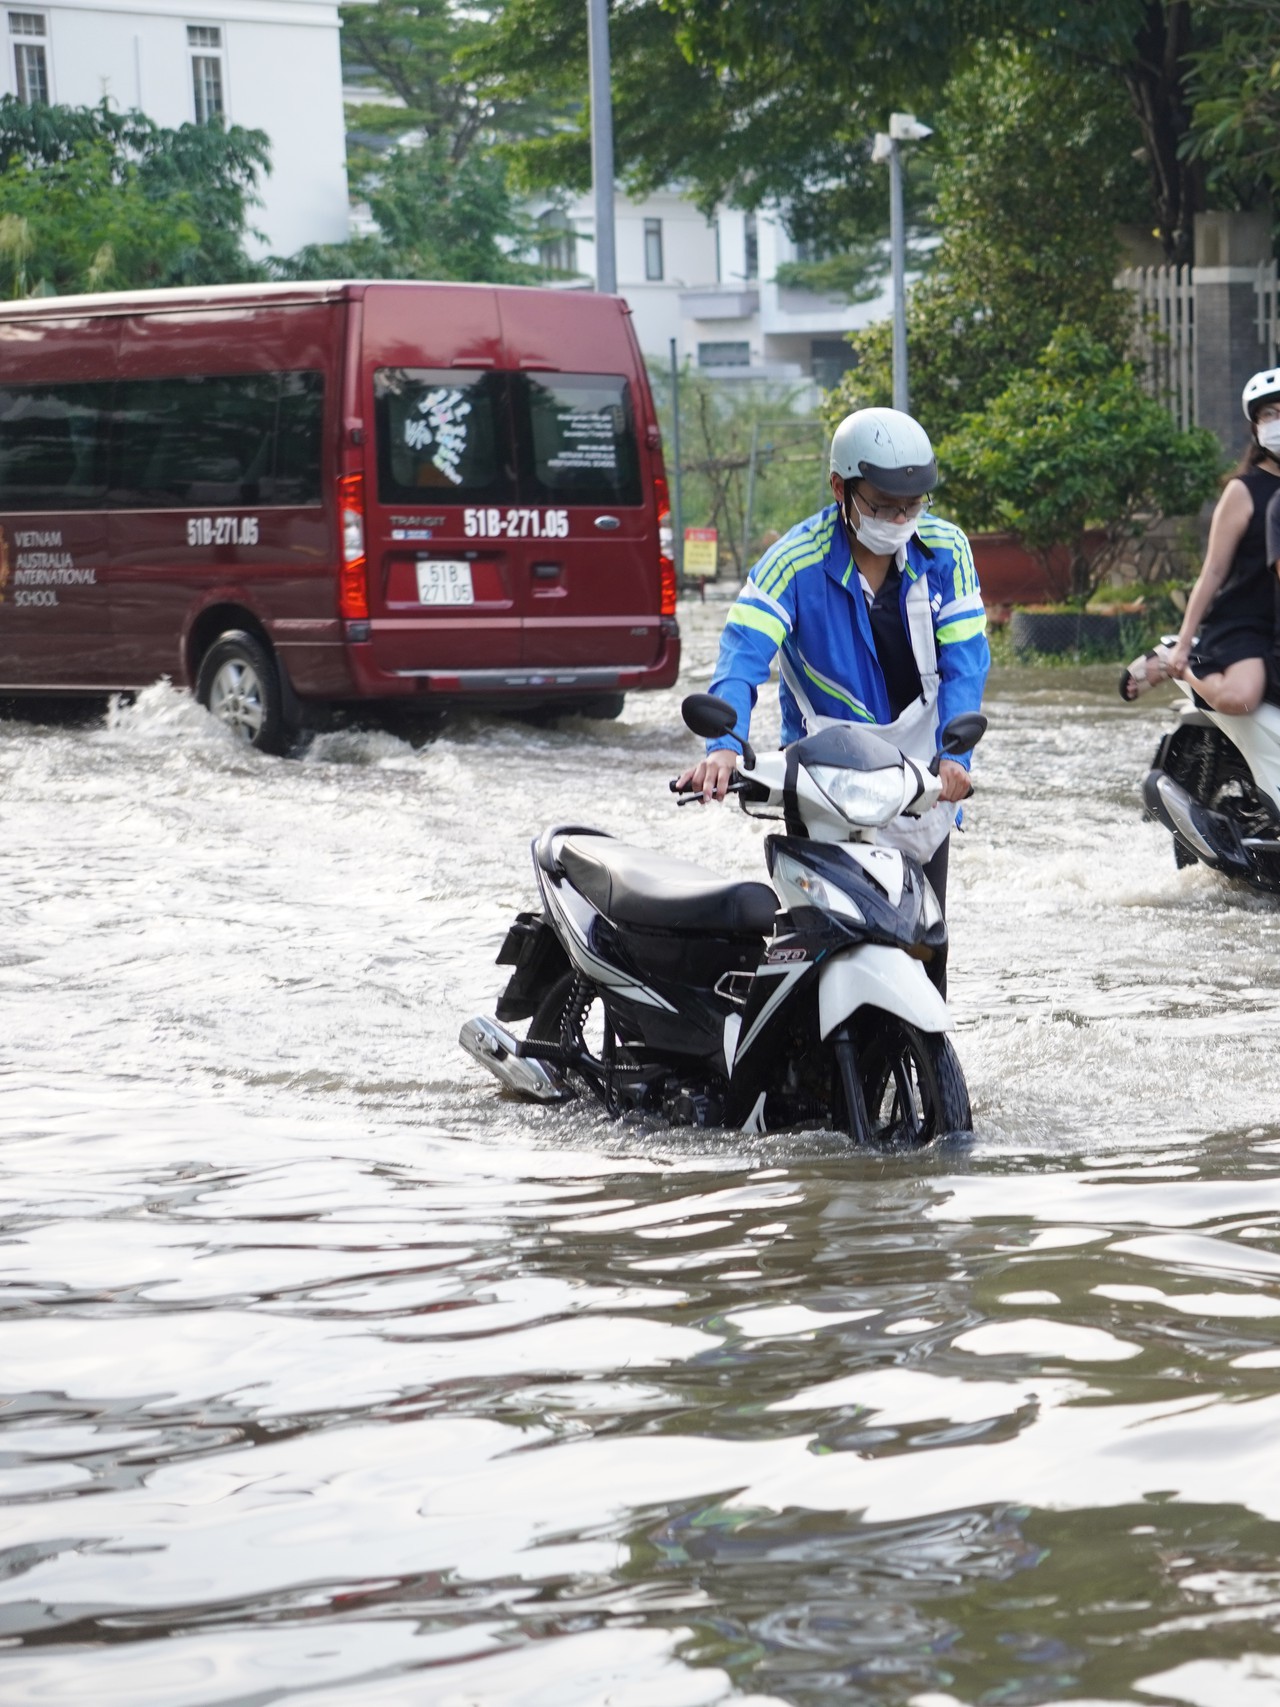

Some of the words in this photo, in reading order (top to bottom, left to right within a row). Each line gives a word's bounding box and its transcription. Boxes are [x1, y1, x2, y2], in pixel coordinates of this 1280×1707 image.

[390, 516, 446, 526] TRANSIT
[464, 509, 569, 537] 51B-271.05
[14, 531, 62, 548] VIETNAM
[187, 517, 259, 546] 51B-271.05
[16, 552, 74, 569] AUSTRALIA
[14, 568, 97, 586] INTERNATIONAL
[430, 565, 458, 582] 51B
[14, 590, 60, 607] SCHOOL
